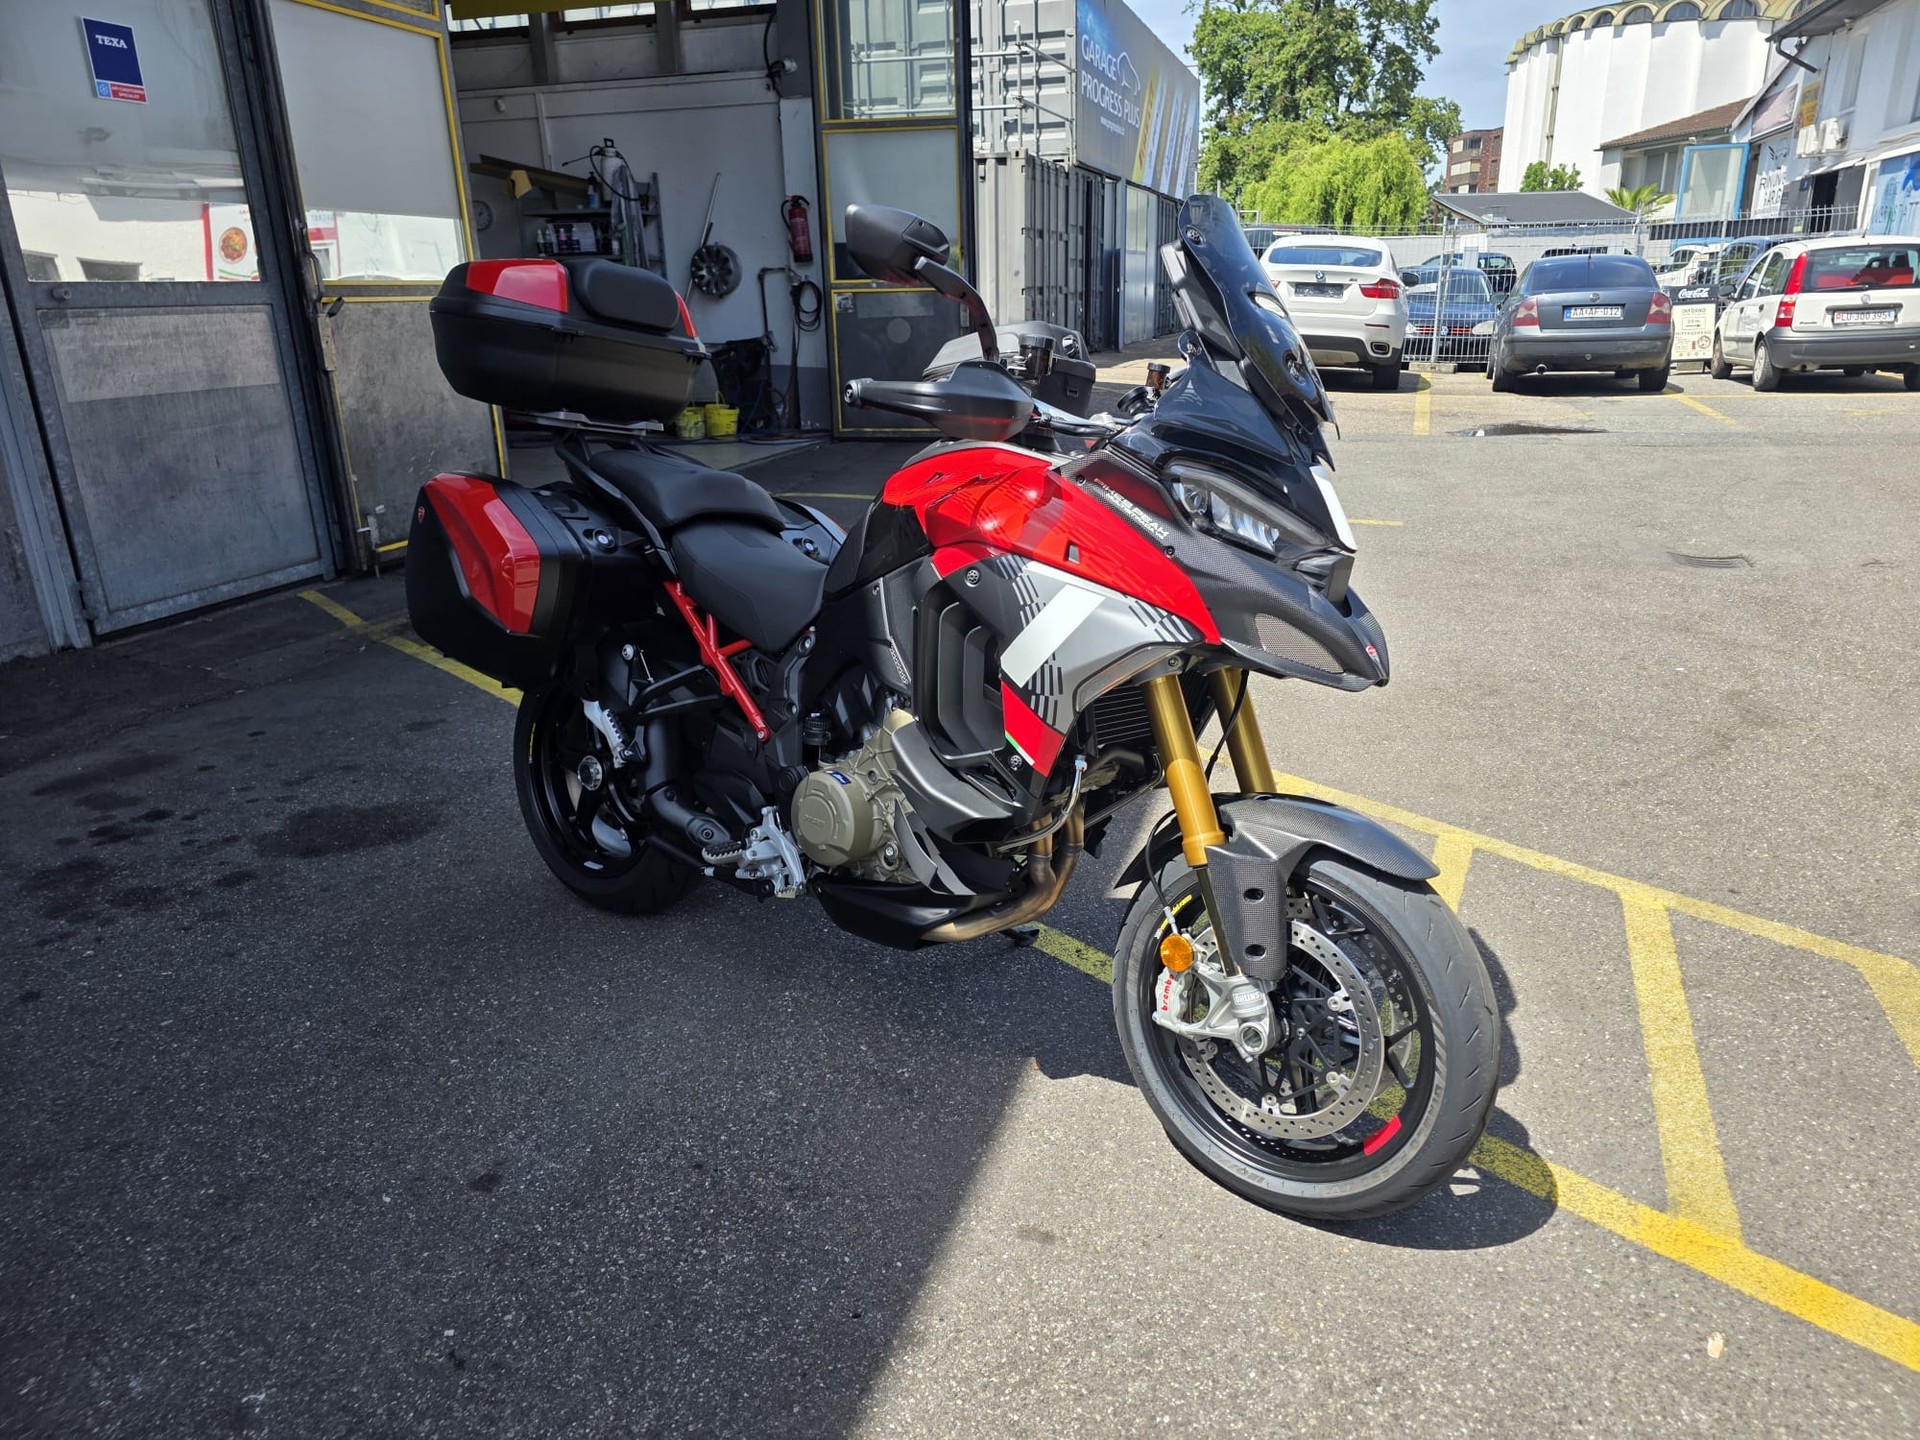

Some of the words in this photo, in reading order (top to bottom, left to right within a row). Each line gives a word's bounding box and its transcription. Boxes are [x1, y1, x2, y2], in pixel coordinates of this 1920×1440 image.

[95, 34, 128, 49] TEXA
[1081, 34, 1117, 80] GARAGE
[1081, 69, 1122, 117] PROGRESS
[1123, 99, 1140, 128] PLUS
[1161, 973, 1175, 1011] brembo
